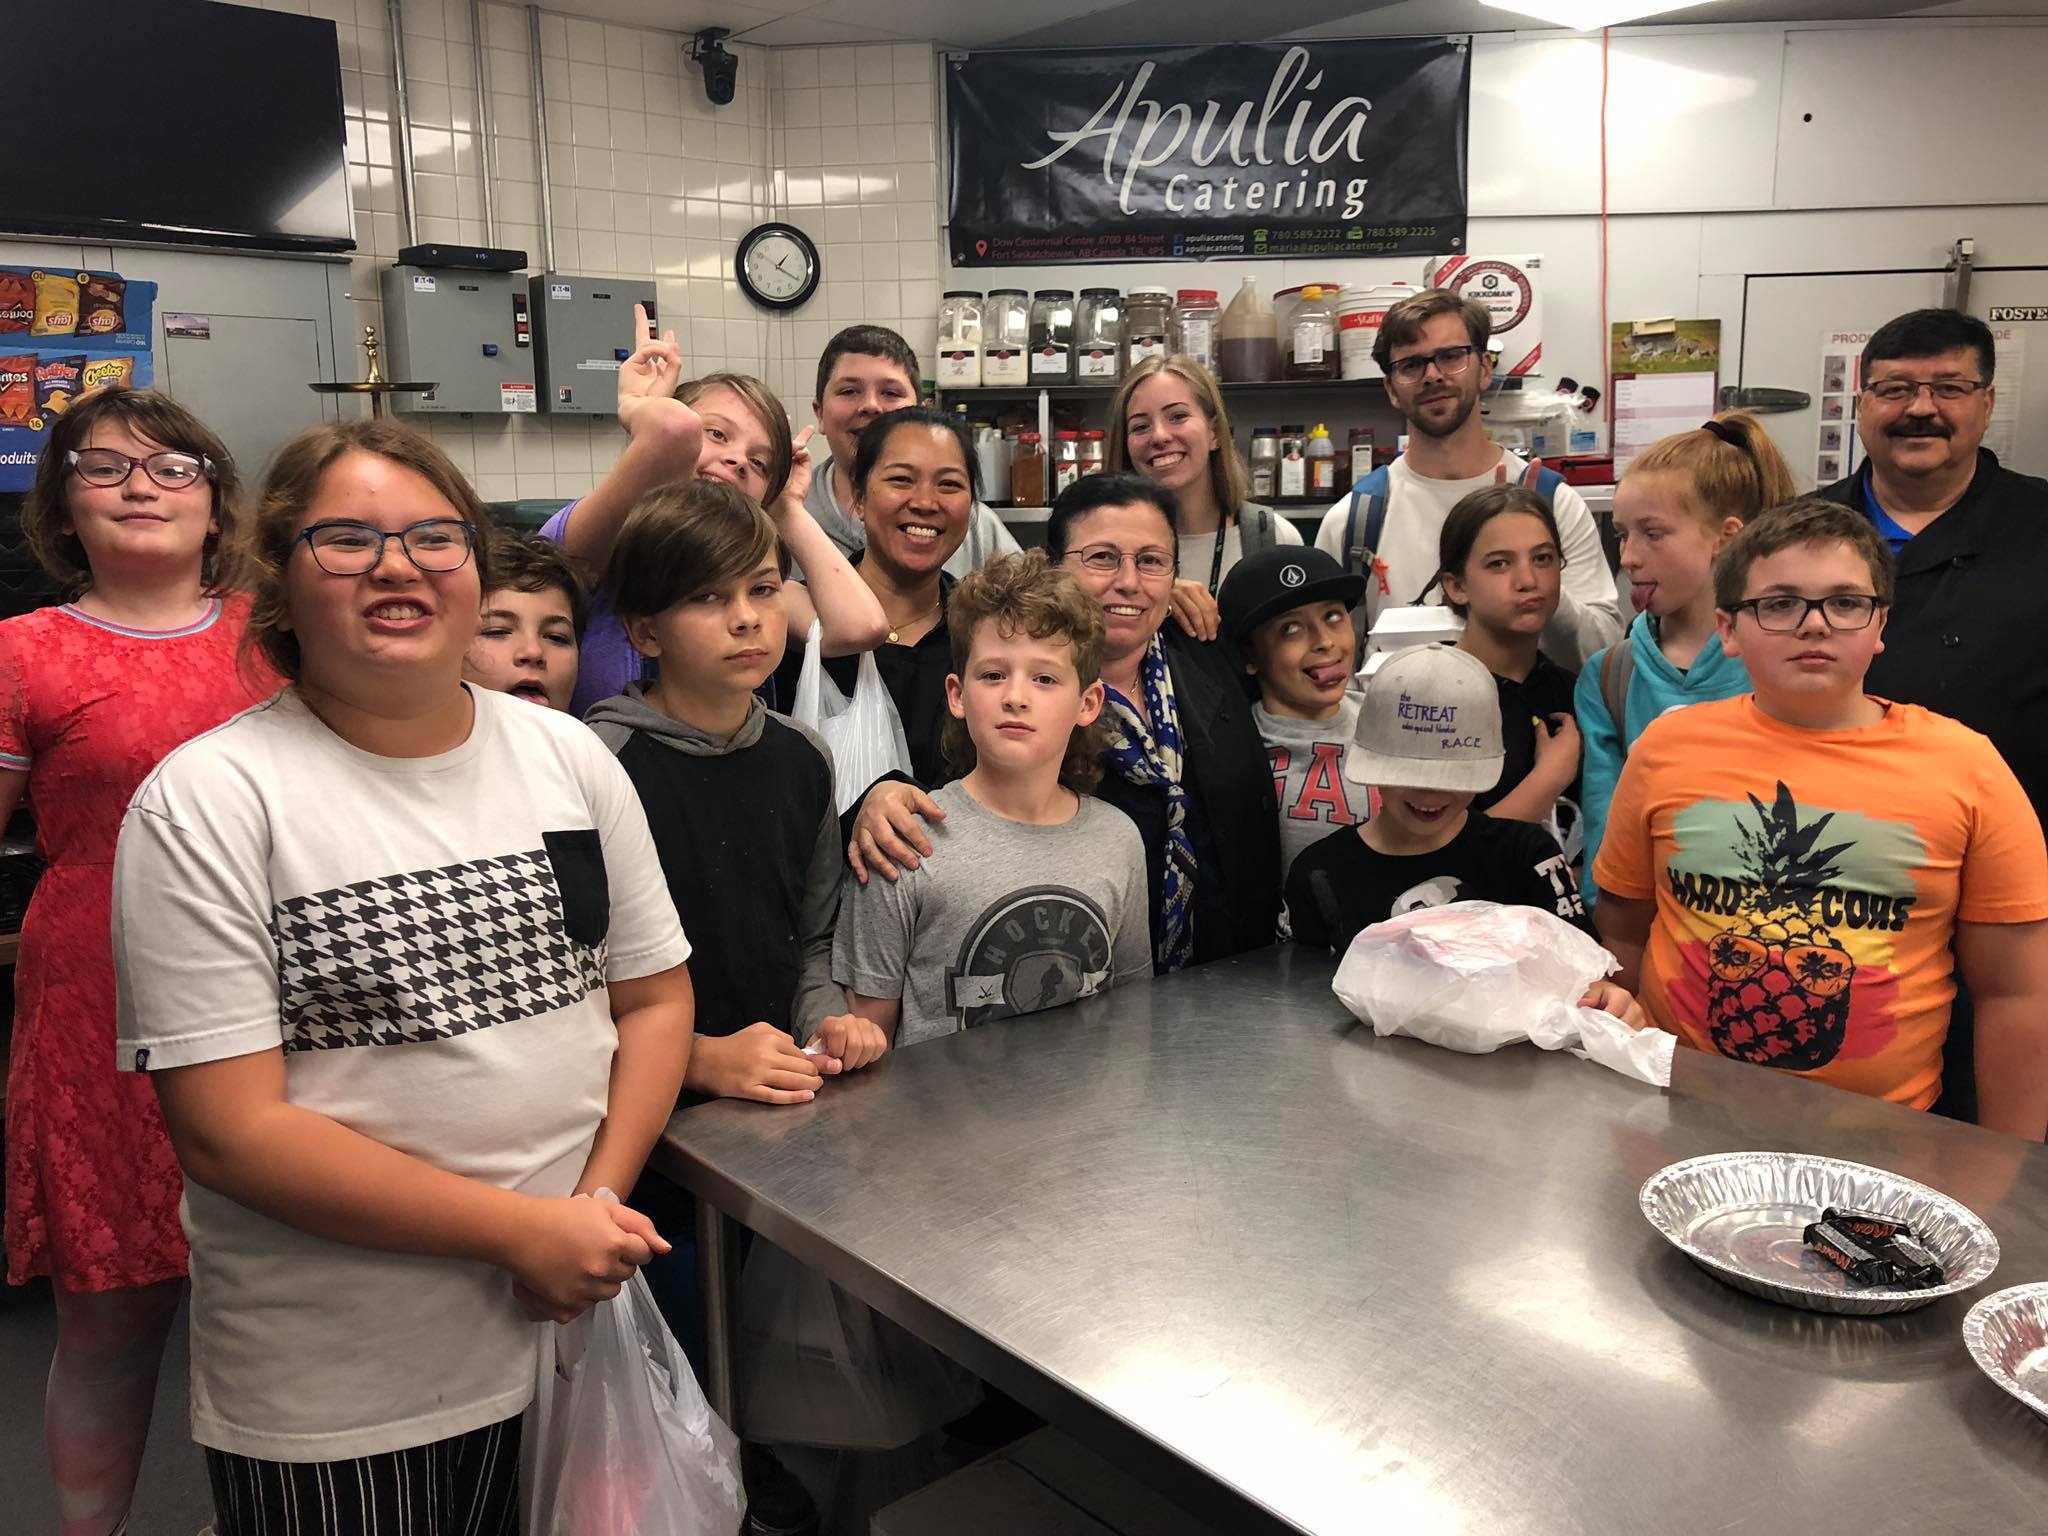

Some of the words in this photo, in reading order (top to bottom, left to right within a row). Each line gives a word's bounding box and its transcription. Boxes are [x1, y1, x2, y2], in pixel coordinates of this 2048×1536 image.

[1020, 46, 1372, 215] Apulia
[1165, 169, 1367, 219] Catering
[1185, 233, 1245, 243] apuliacatering
[1272, 229, 1341, 240] 780.589.2222
[1367, 227, 1437, 237] 780.589.2225
[1185, 243, 1245, 253] apuliacatering
[1467, 290, 1512, 299] KIKKOMAN
[85, 363, 123, 385] Cheetos
[30, 420, 41, 429] 16
[1400, 690, 1412, 702] the
[1397, 703, 1458, 723] RETREAT
[1667, 866, 1741, 917] HARD
[1821, 885, 1917, 932] CORE
[983, 905, 1103, 972] HOCKEY
